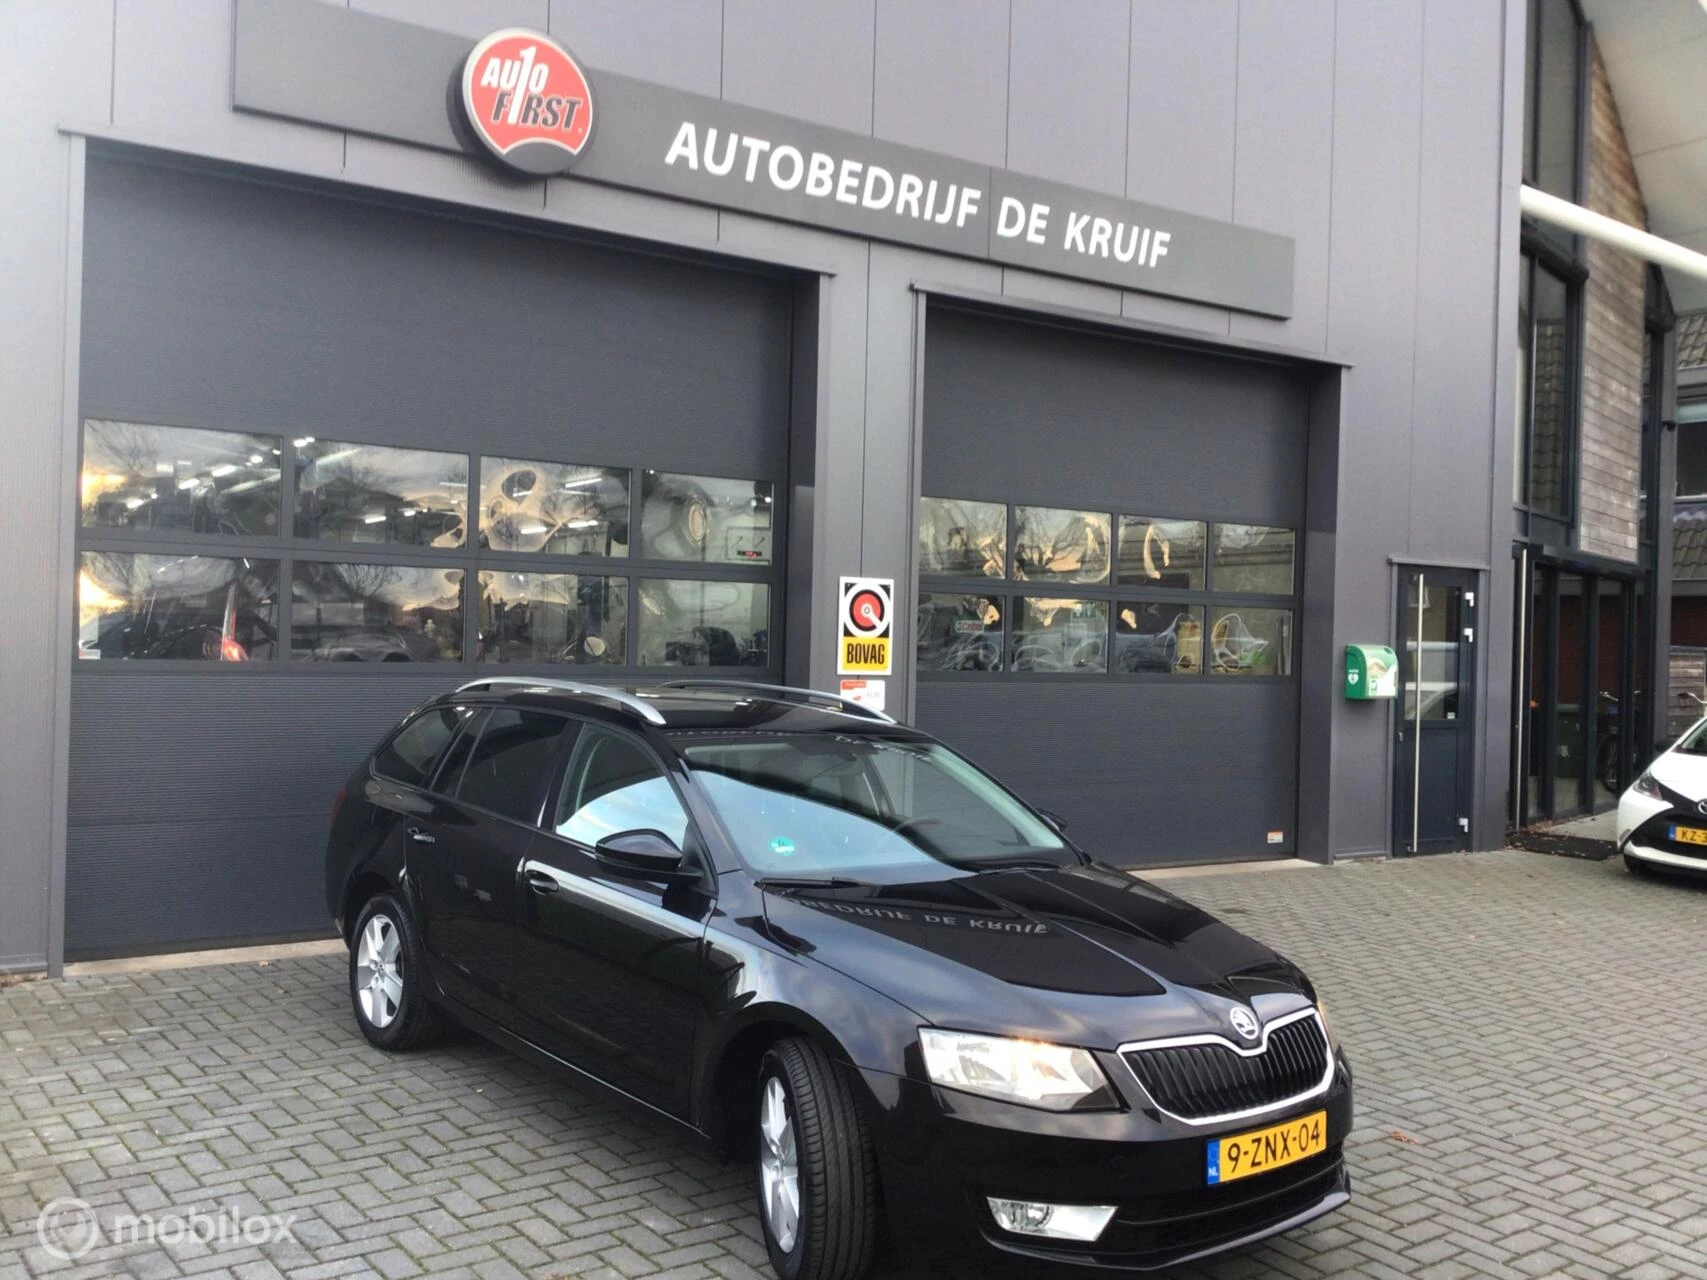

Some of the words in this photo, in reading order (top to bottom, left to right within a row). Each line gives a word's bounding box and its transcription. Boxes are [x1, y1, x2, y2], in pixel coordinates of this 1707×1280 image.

[664, 121, 982, 228] AUTOBEDRIJF
[997, 196, 1050, 245] DE
[1063, 211, 1171, 268] KRUIF
[846, 643, 885, 665] BOVAG
[1227, 1119, 1321, 1173] 9-ZNX-04
